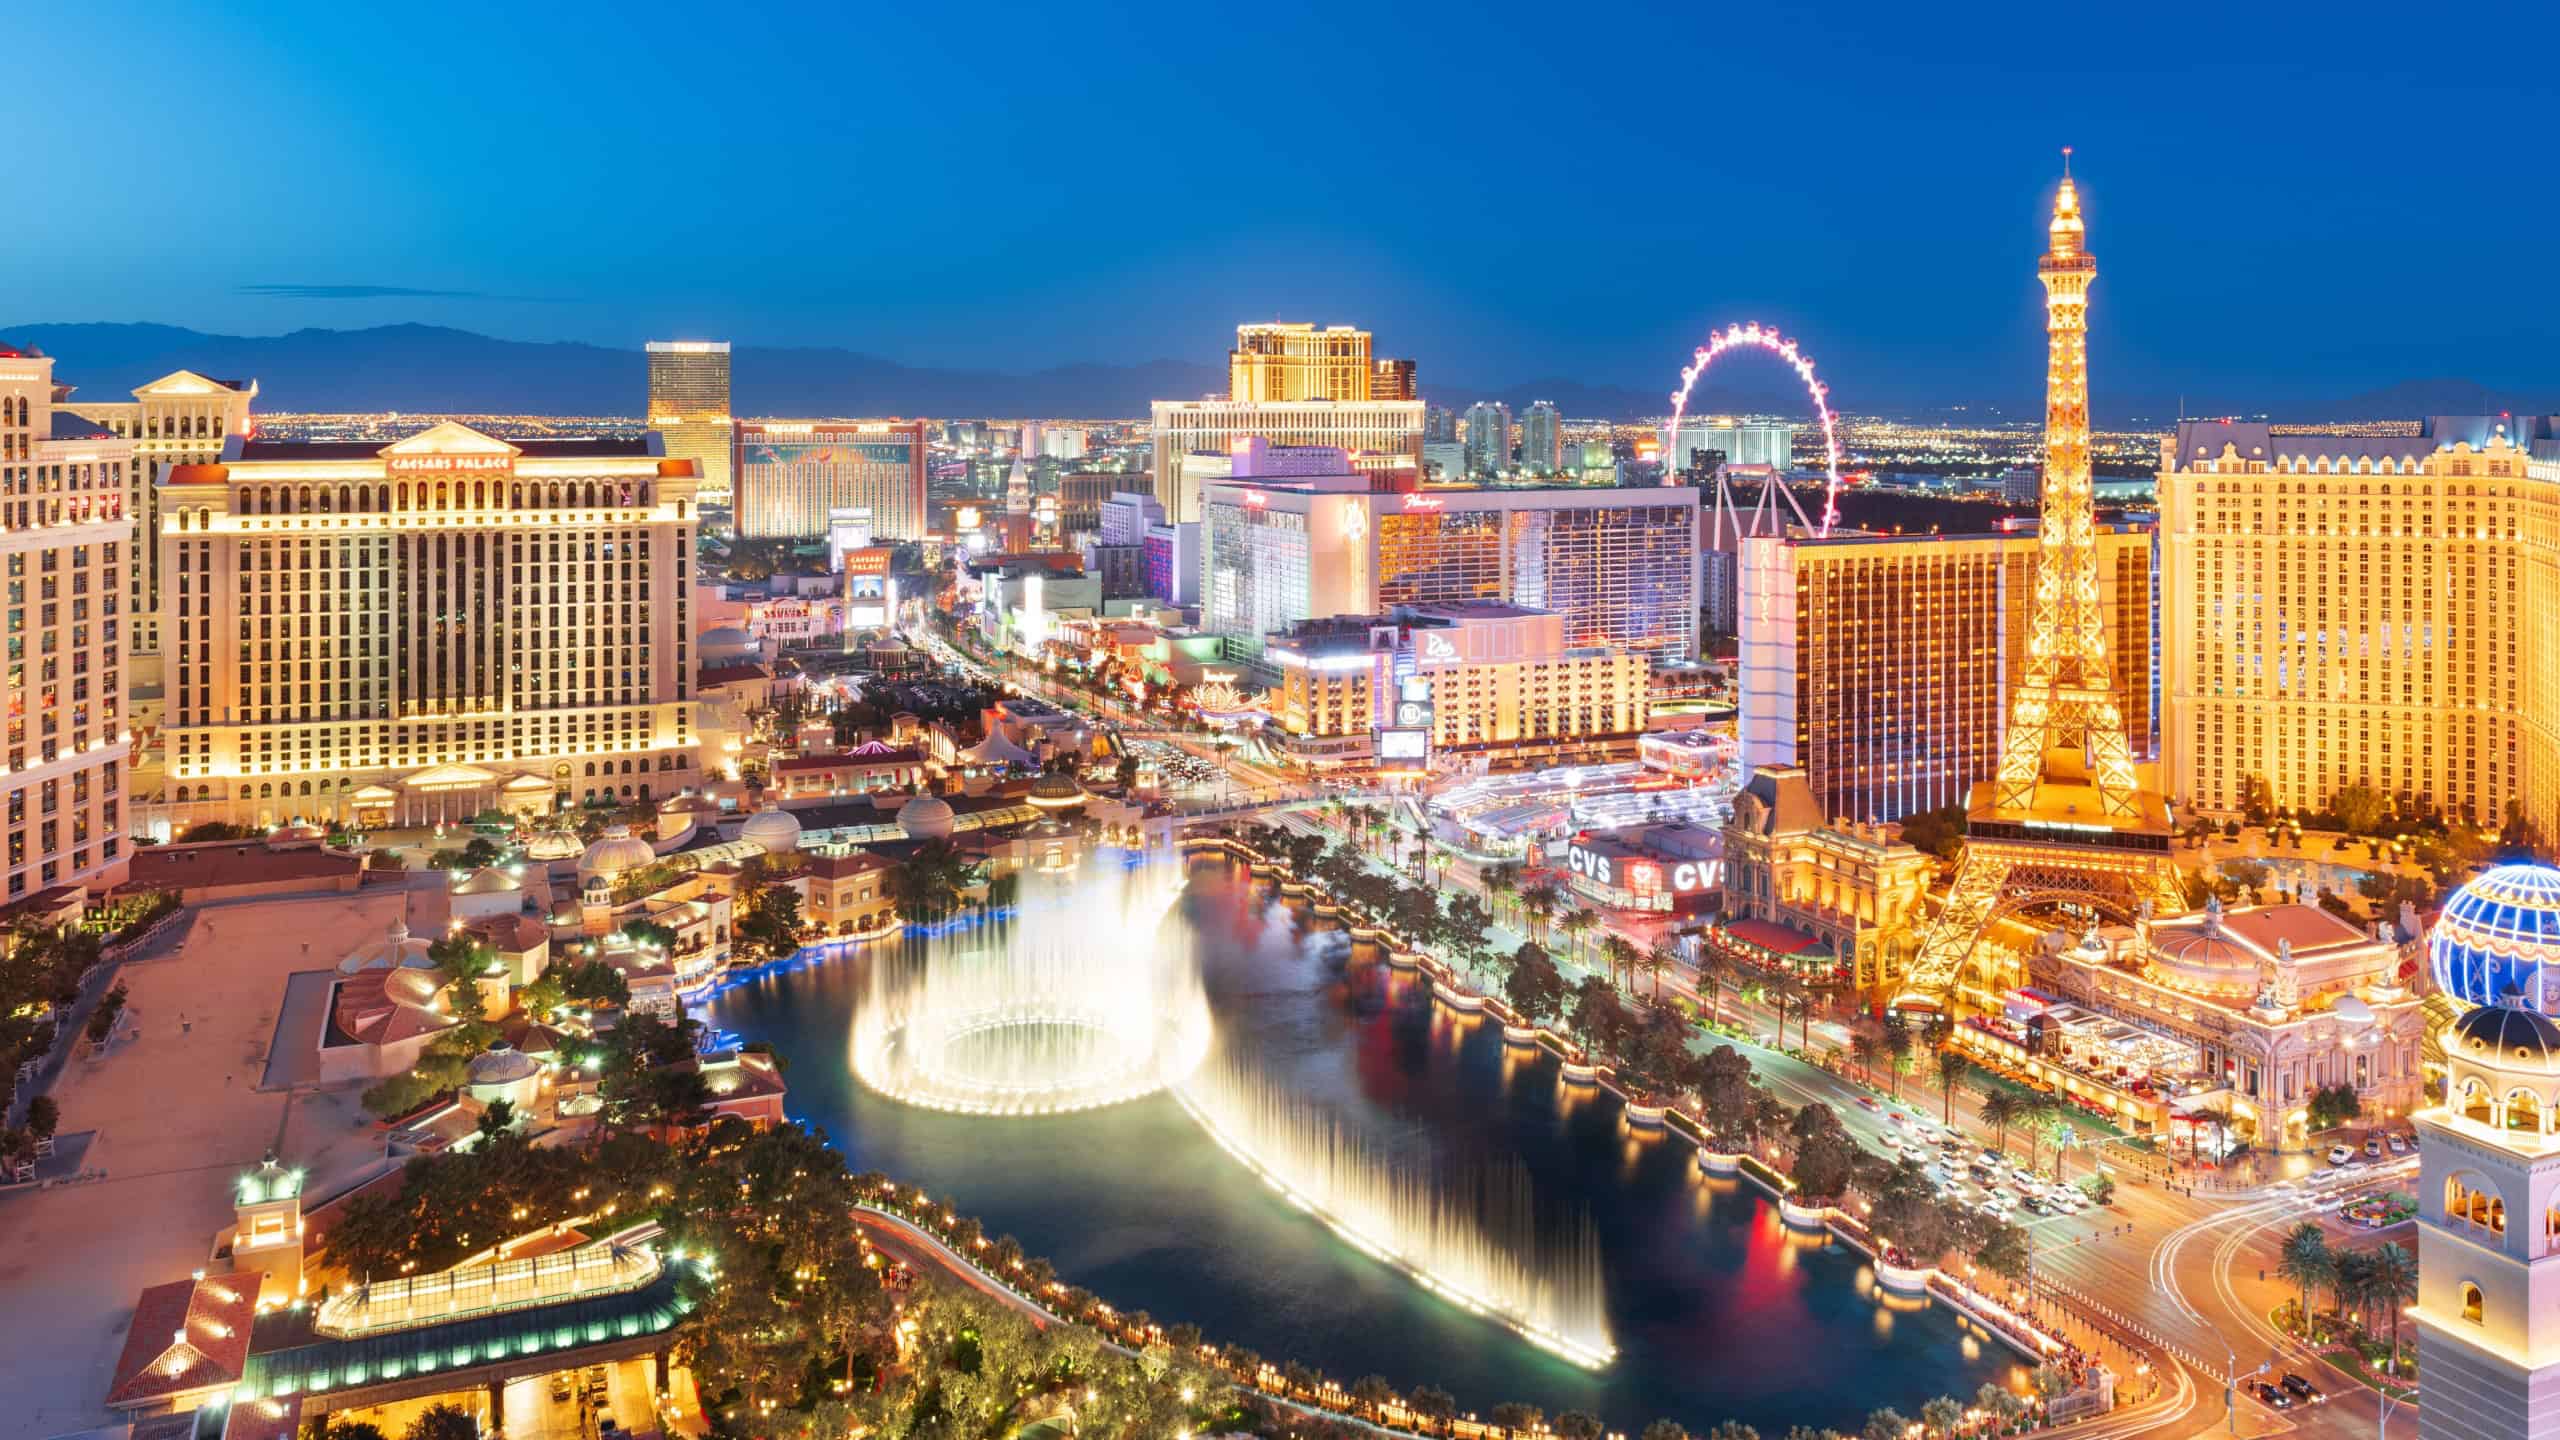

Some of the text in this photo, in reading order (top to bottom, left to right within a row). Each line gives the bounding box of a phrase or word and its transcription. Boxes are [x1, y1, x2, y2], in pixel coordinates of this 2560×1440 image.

[391, 458, 509, 470] CAESARS PALACE
[1569, 846, 1611, 884] CVS
